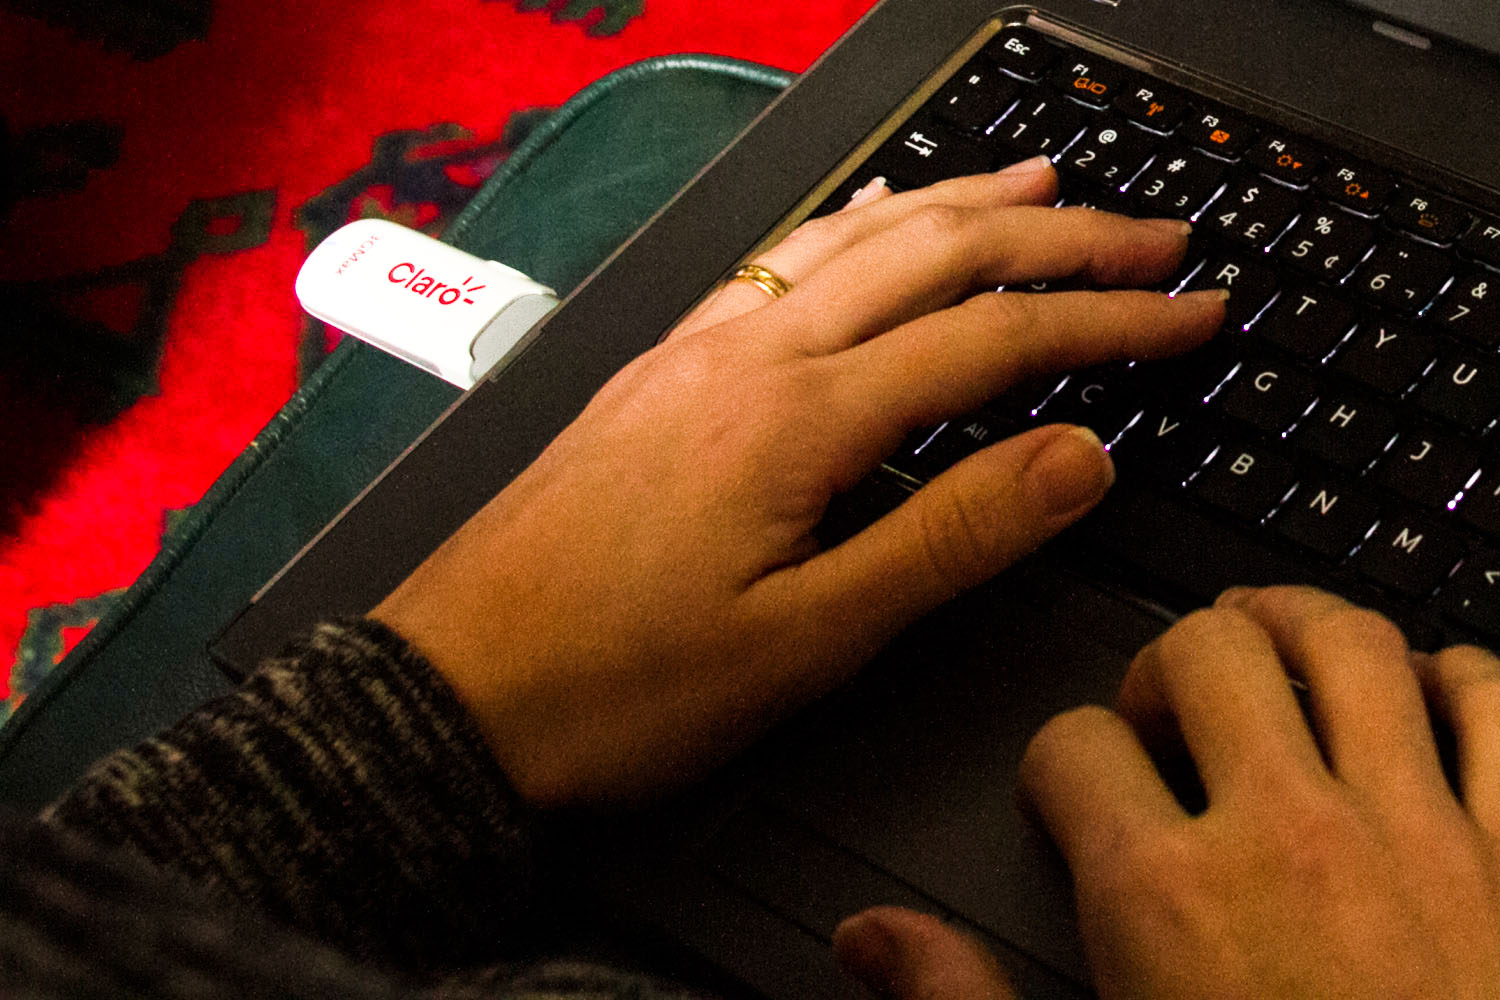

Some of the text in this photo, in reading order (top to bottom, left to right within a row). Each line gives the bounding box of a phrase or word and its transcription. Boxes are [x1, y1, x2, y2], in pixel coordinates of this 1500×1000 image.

[1003, 37, 1031, 57] Esc
[1072, 63, 1090, 77] F1
[1136, 88, 1154, 102] F2
[1202, 114, 1220, 129] F3
[1268, 139, 1286, 154] F4
[1075, 150, 1096, 168] 2
[1337, 168, 1355, 182] F5
[1145, 179, 1165, 197] 3
[1410, 198, 1428, 212] F6
[1218, 210, 1239, 228] 4
[1292, 240, 1314, 258] 5
[386, 261, 462, 306] Claro
[1215, 263, 1241, 286] R
[1370, 273, 1391, 291] 6
[1295, 294, 1317, 316] T
[1448, 304, 1471, 322] 7
[1374, 328, 1397, 350] Y
[1254, 370, 1279, 393] G
[1452, 363, 1478, 386] U
[1329, 404, 1356, 428] H
[1157, 416, 1180, 437] V
[1409, 440, 1432, 462] J
[1229, 452, 1255, 475] B
[1309, 490, 1338, 515] N
[1391, 528, 1423, 554] M
